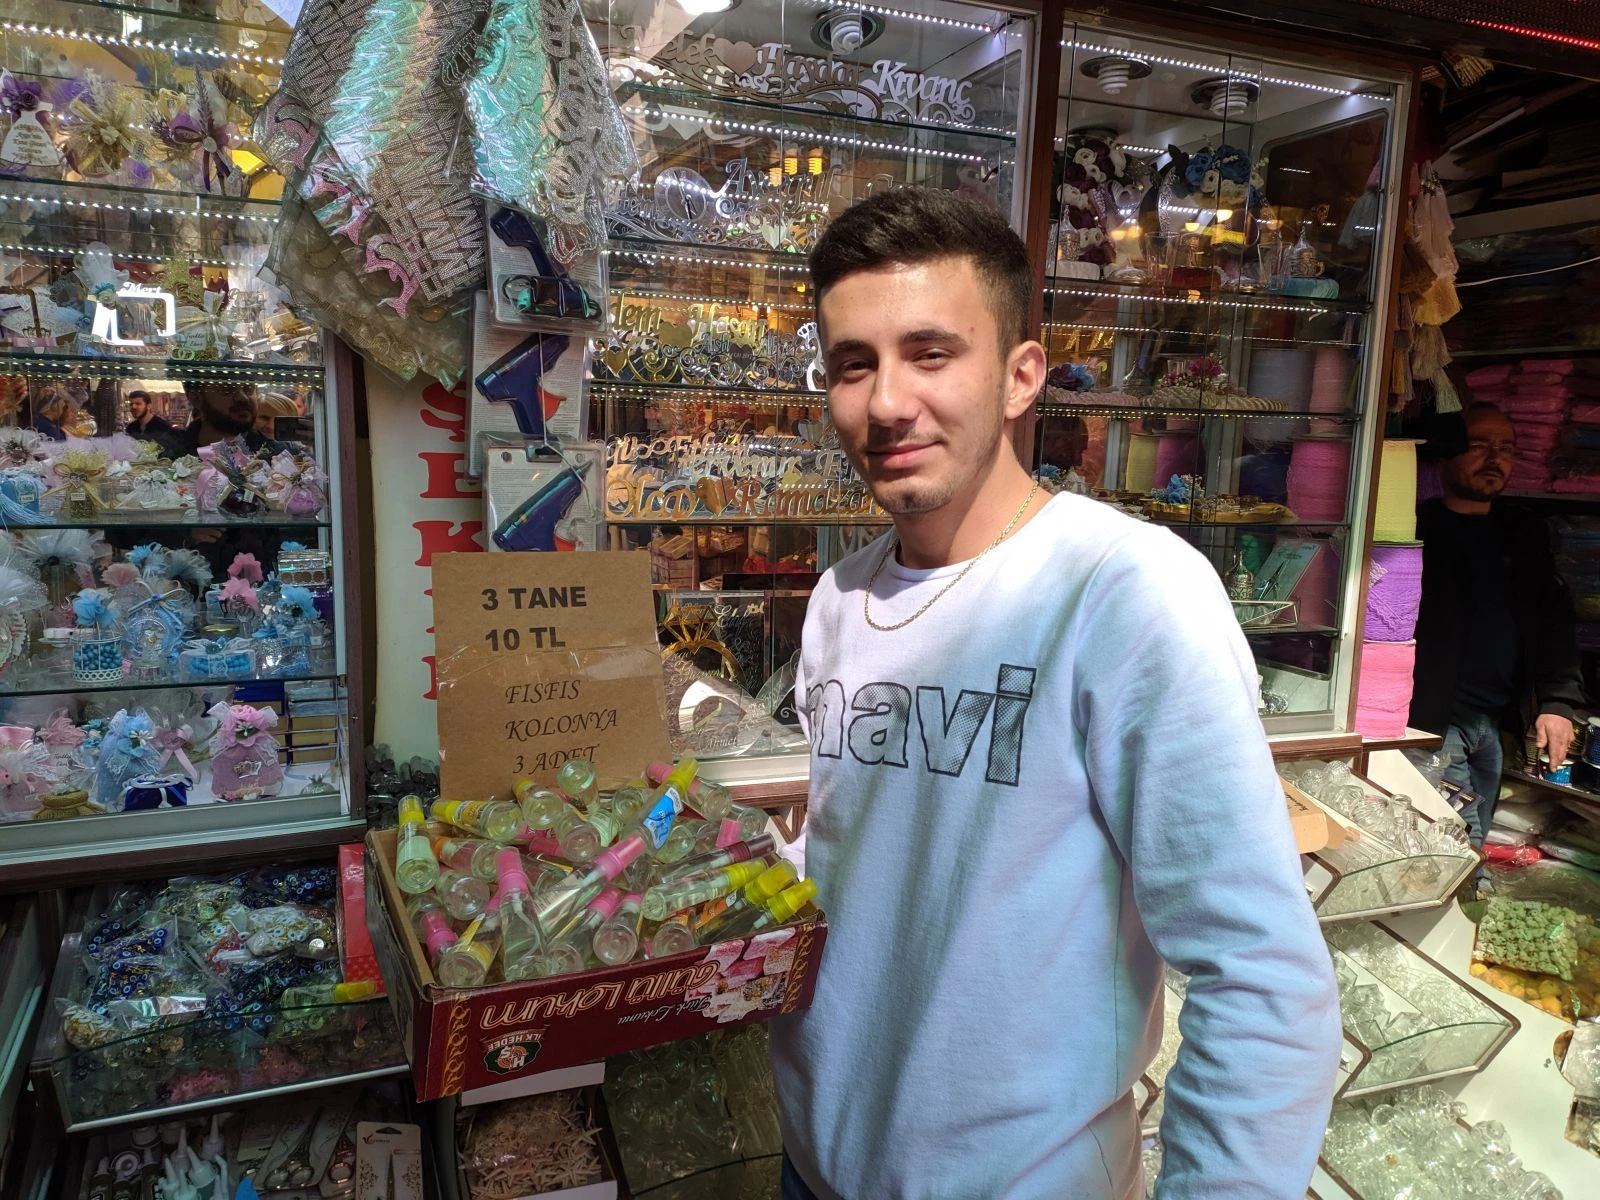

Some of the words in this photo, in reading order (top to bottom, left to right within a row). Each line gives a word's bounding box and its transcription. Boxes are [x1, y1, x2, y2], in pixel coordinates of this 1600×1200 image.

[482, 588, 498, 611] 3
[508, 586, 587, 610] TANE
[485, 629, 520, 652] 10
[530, 626, 566, 649] TL
[504, 680, 581, 705] FISFIS
[505, 708, 619, 742] KOLONYA
[806, 663, 1037, 787] mavi
[513, 755, 524, 773] 3
[528, 744, 600, 775] ADET
[622, 959, 721, 1003] Güllü
[479, 979, 624, 1029] Lokum
